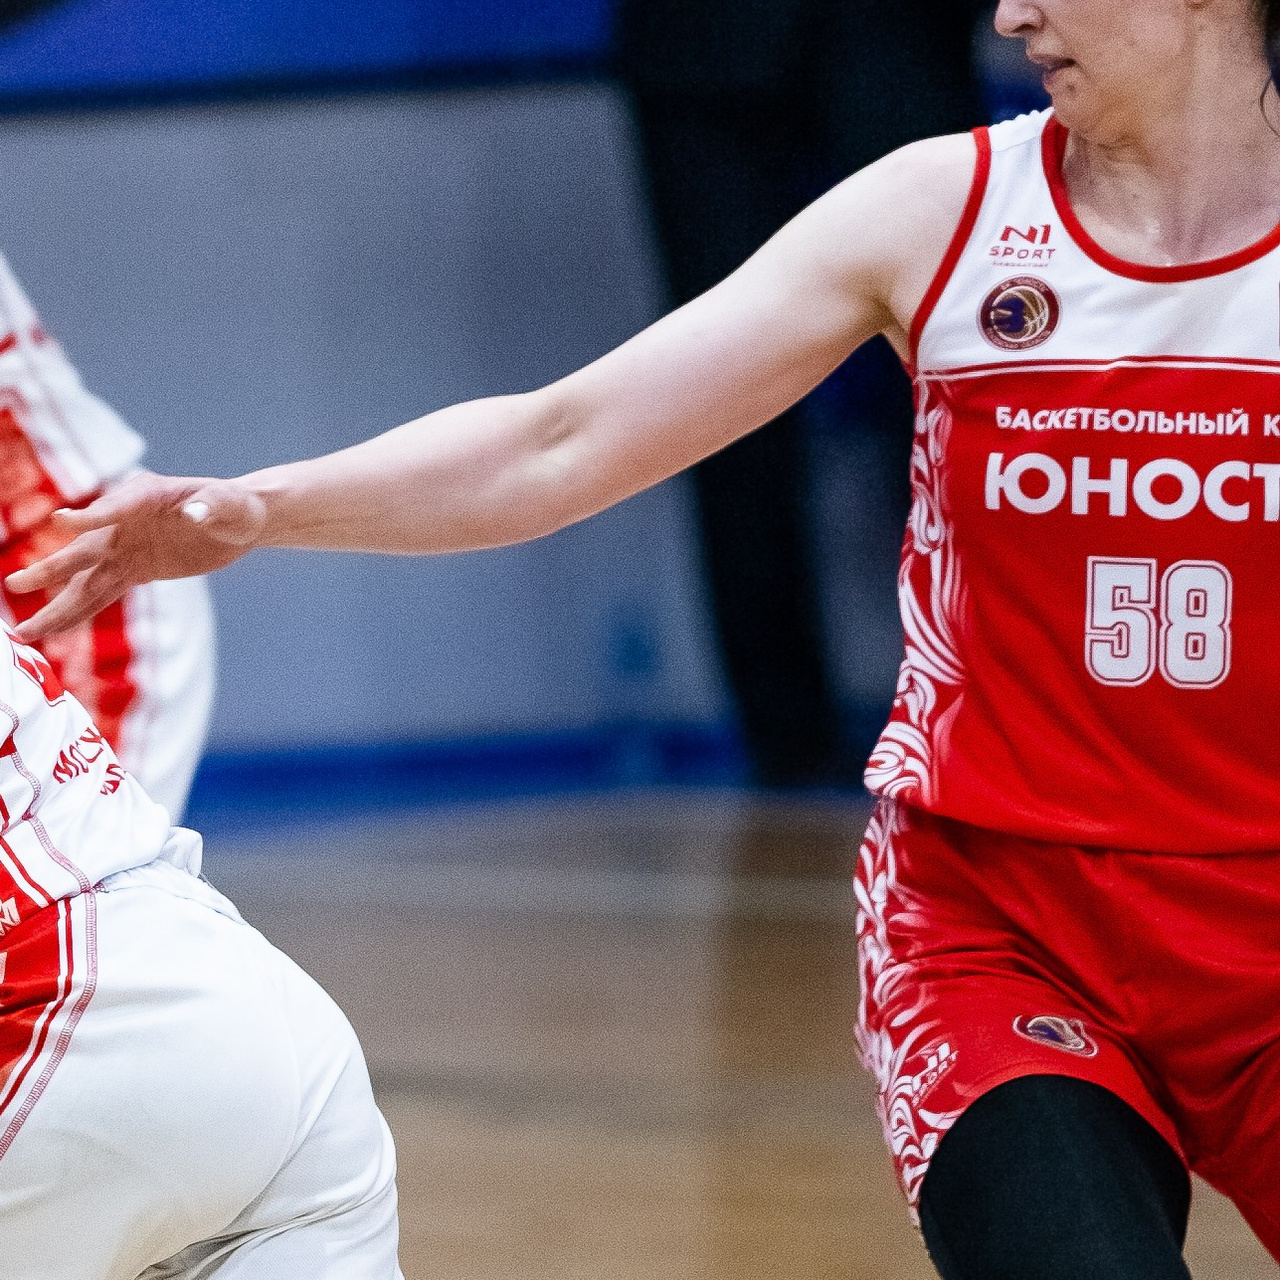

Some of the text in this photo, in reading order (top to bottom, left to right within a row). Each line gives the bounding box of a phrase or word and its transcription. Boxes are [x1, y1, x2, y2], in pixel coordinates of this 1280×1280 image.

[988, 245, 1056, 260] SPORT
[995, 406, 1249, 436] БАСКЕТБОЛЬНЫЙ
[985, 452, 1280, 522] ЮНОСТ
[1084, 555, 1233, 690] 58
